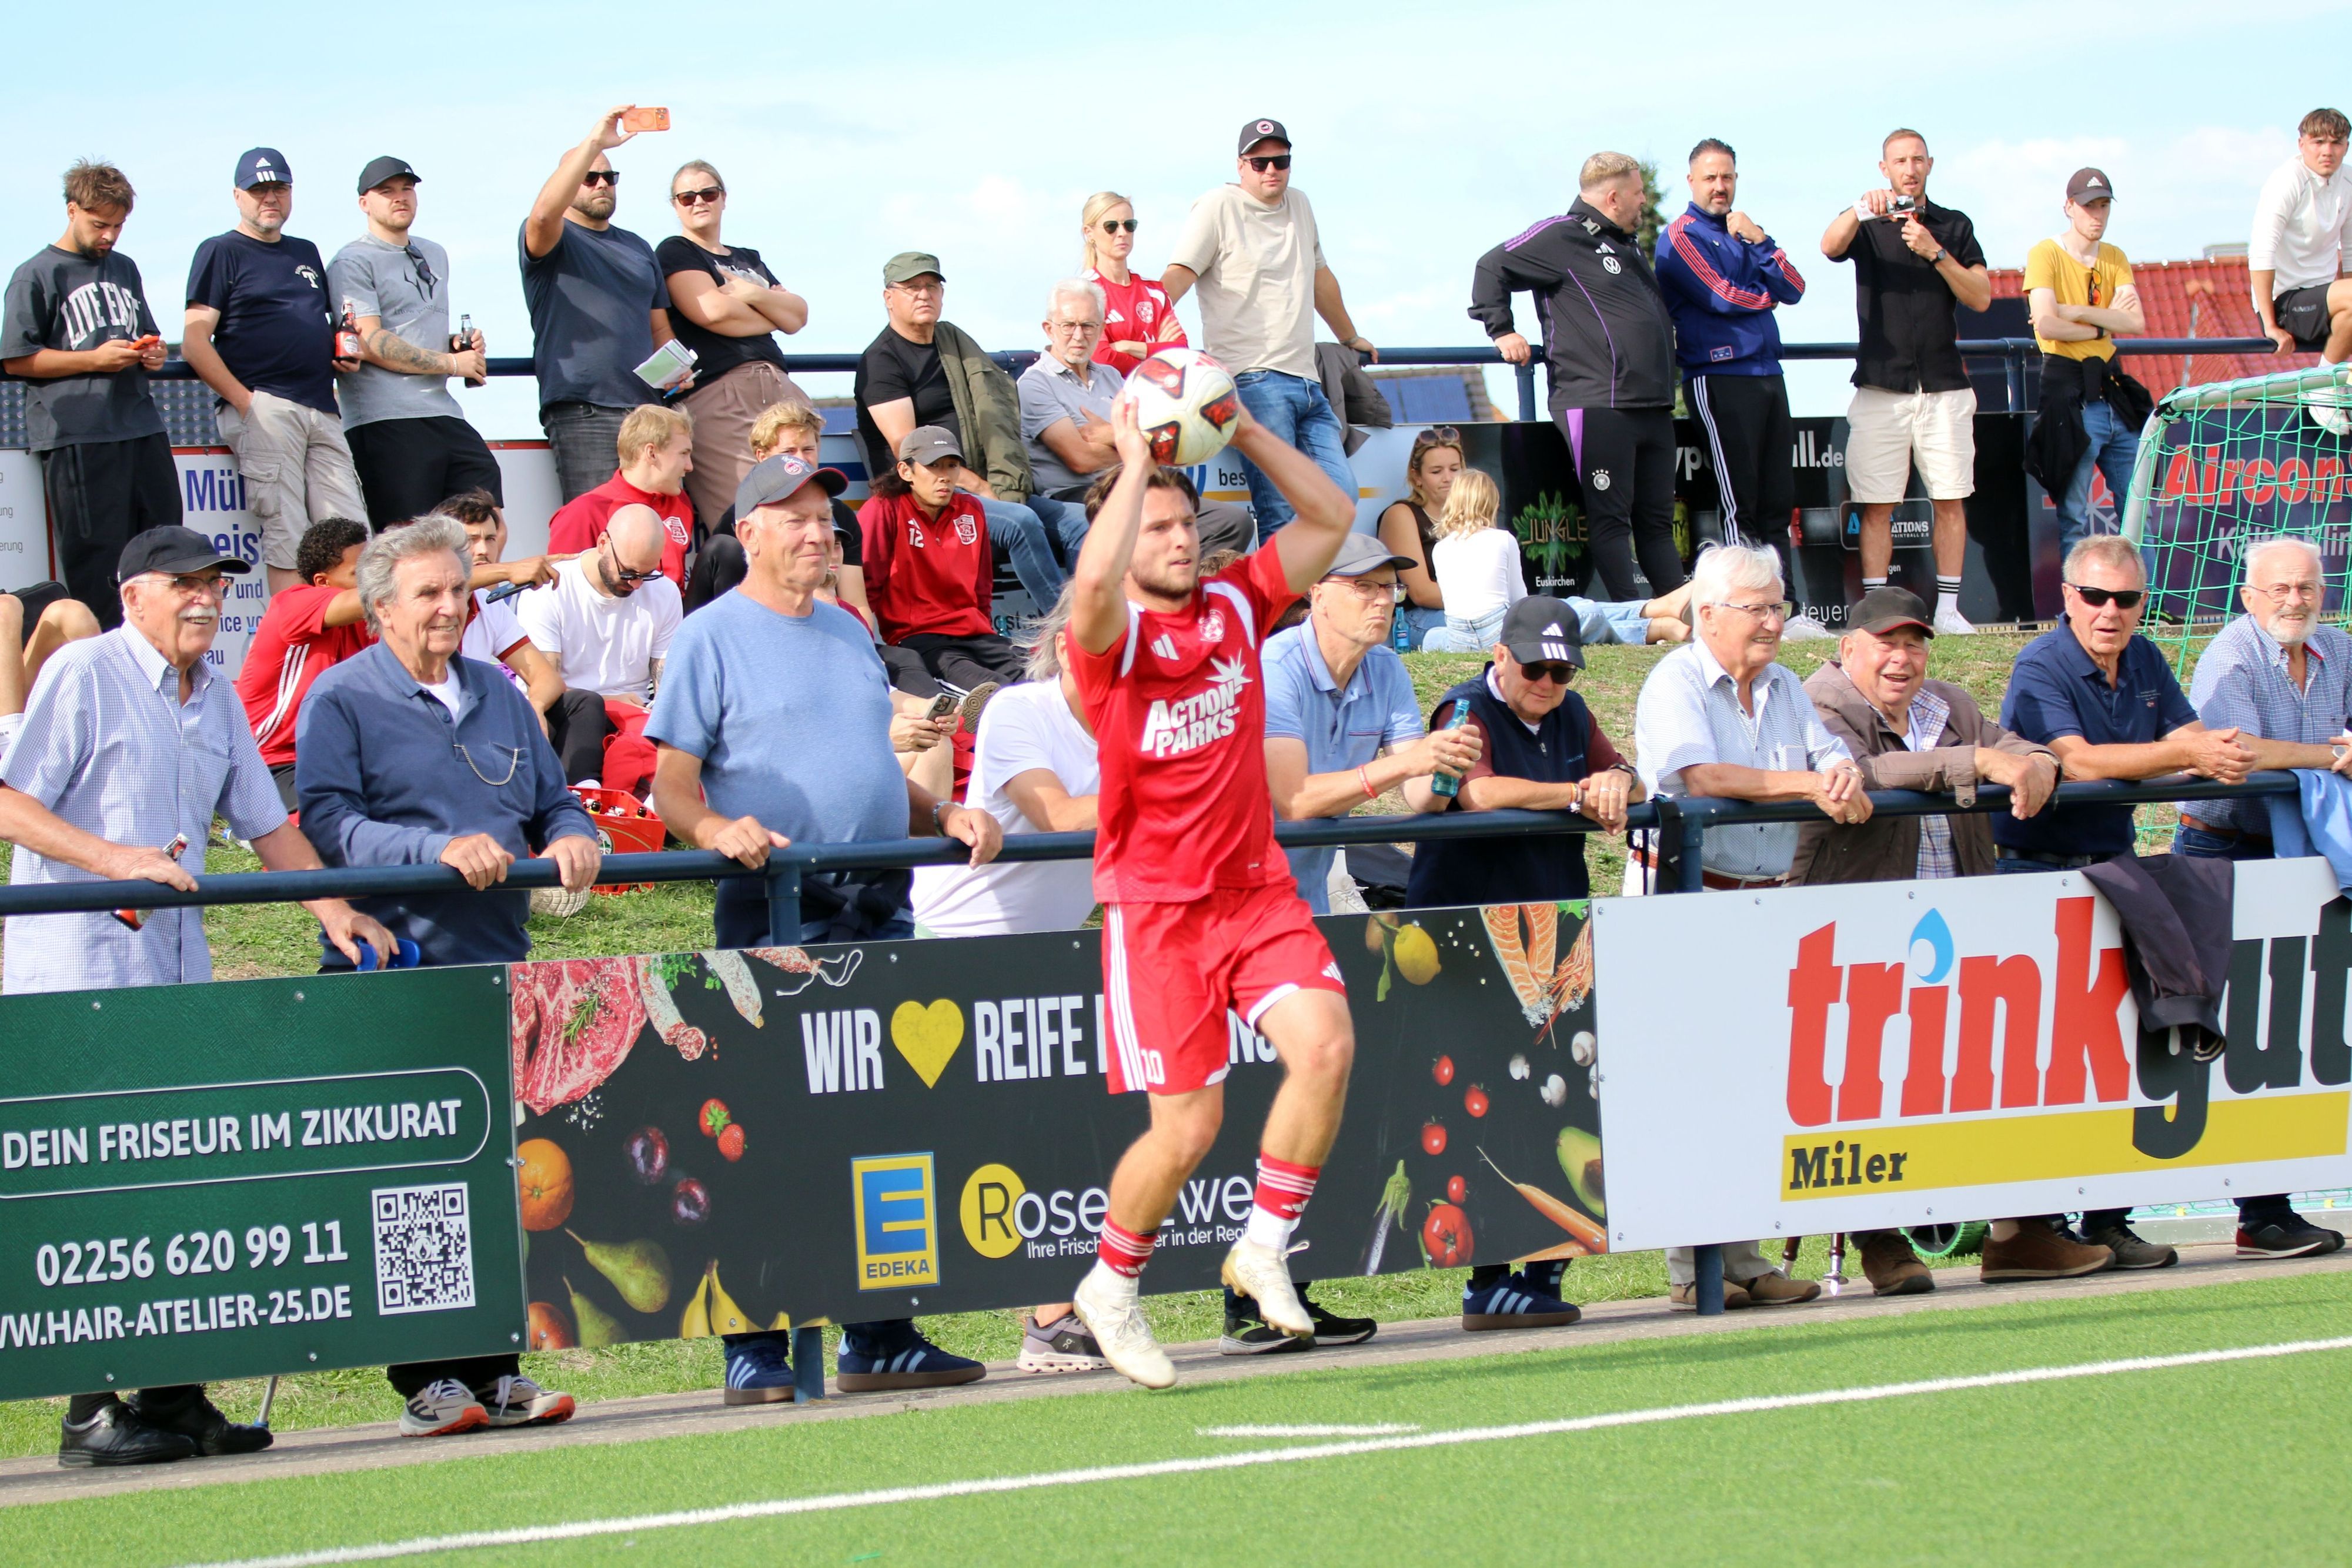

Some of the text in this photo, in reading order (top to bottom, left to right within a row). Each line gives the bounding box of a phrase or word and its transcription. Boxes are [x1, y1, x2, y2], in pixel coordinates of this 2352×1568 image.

[61, 282, 107, 351] LIVE
[1218, 468, 1247, 486] bes
[186, 469, 246, 511] Mül
[1521, 515, 1589, 546] JUNGLE
[1891, 520, 1929, 533] ATIONS
[210, 523, 265, 566] eis
[909, 527, 925, 549] 12
[1888, 564, 1901, 574] gen
[236, 579, 263, 599] und
[1535, 574, 1575, 587] Euskirchen
[220, 613, 242, 632] ice
[1801, 601, 1849, 622] teuer
[203, 650, 225, 665] au
[801, 1008, 884, 1094] WIR
[974, 995, 1087, 1082] REIFE
[3, 1099, 462, 1169] DEIN FRISEUR IM ZIKKURAT
[1788, 1139, 1908, 1191] Miler
[1027, 1241, 1056, 1259] Ihre
[1060, 1236, 1101, 1256] Frisch
[1171, 1229, 1185, 1246] in
[1188, 1227, 1213, 1245] der
[1216, 1224, 1248, 1243] Regi
[36, 1219, 348, 1287] 02256 620 99 11
[866, 1259, 930, 1279] EDEKA
